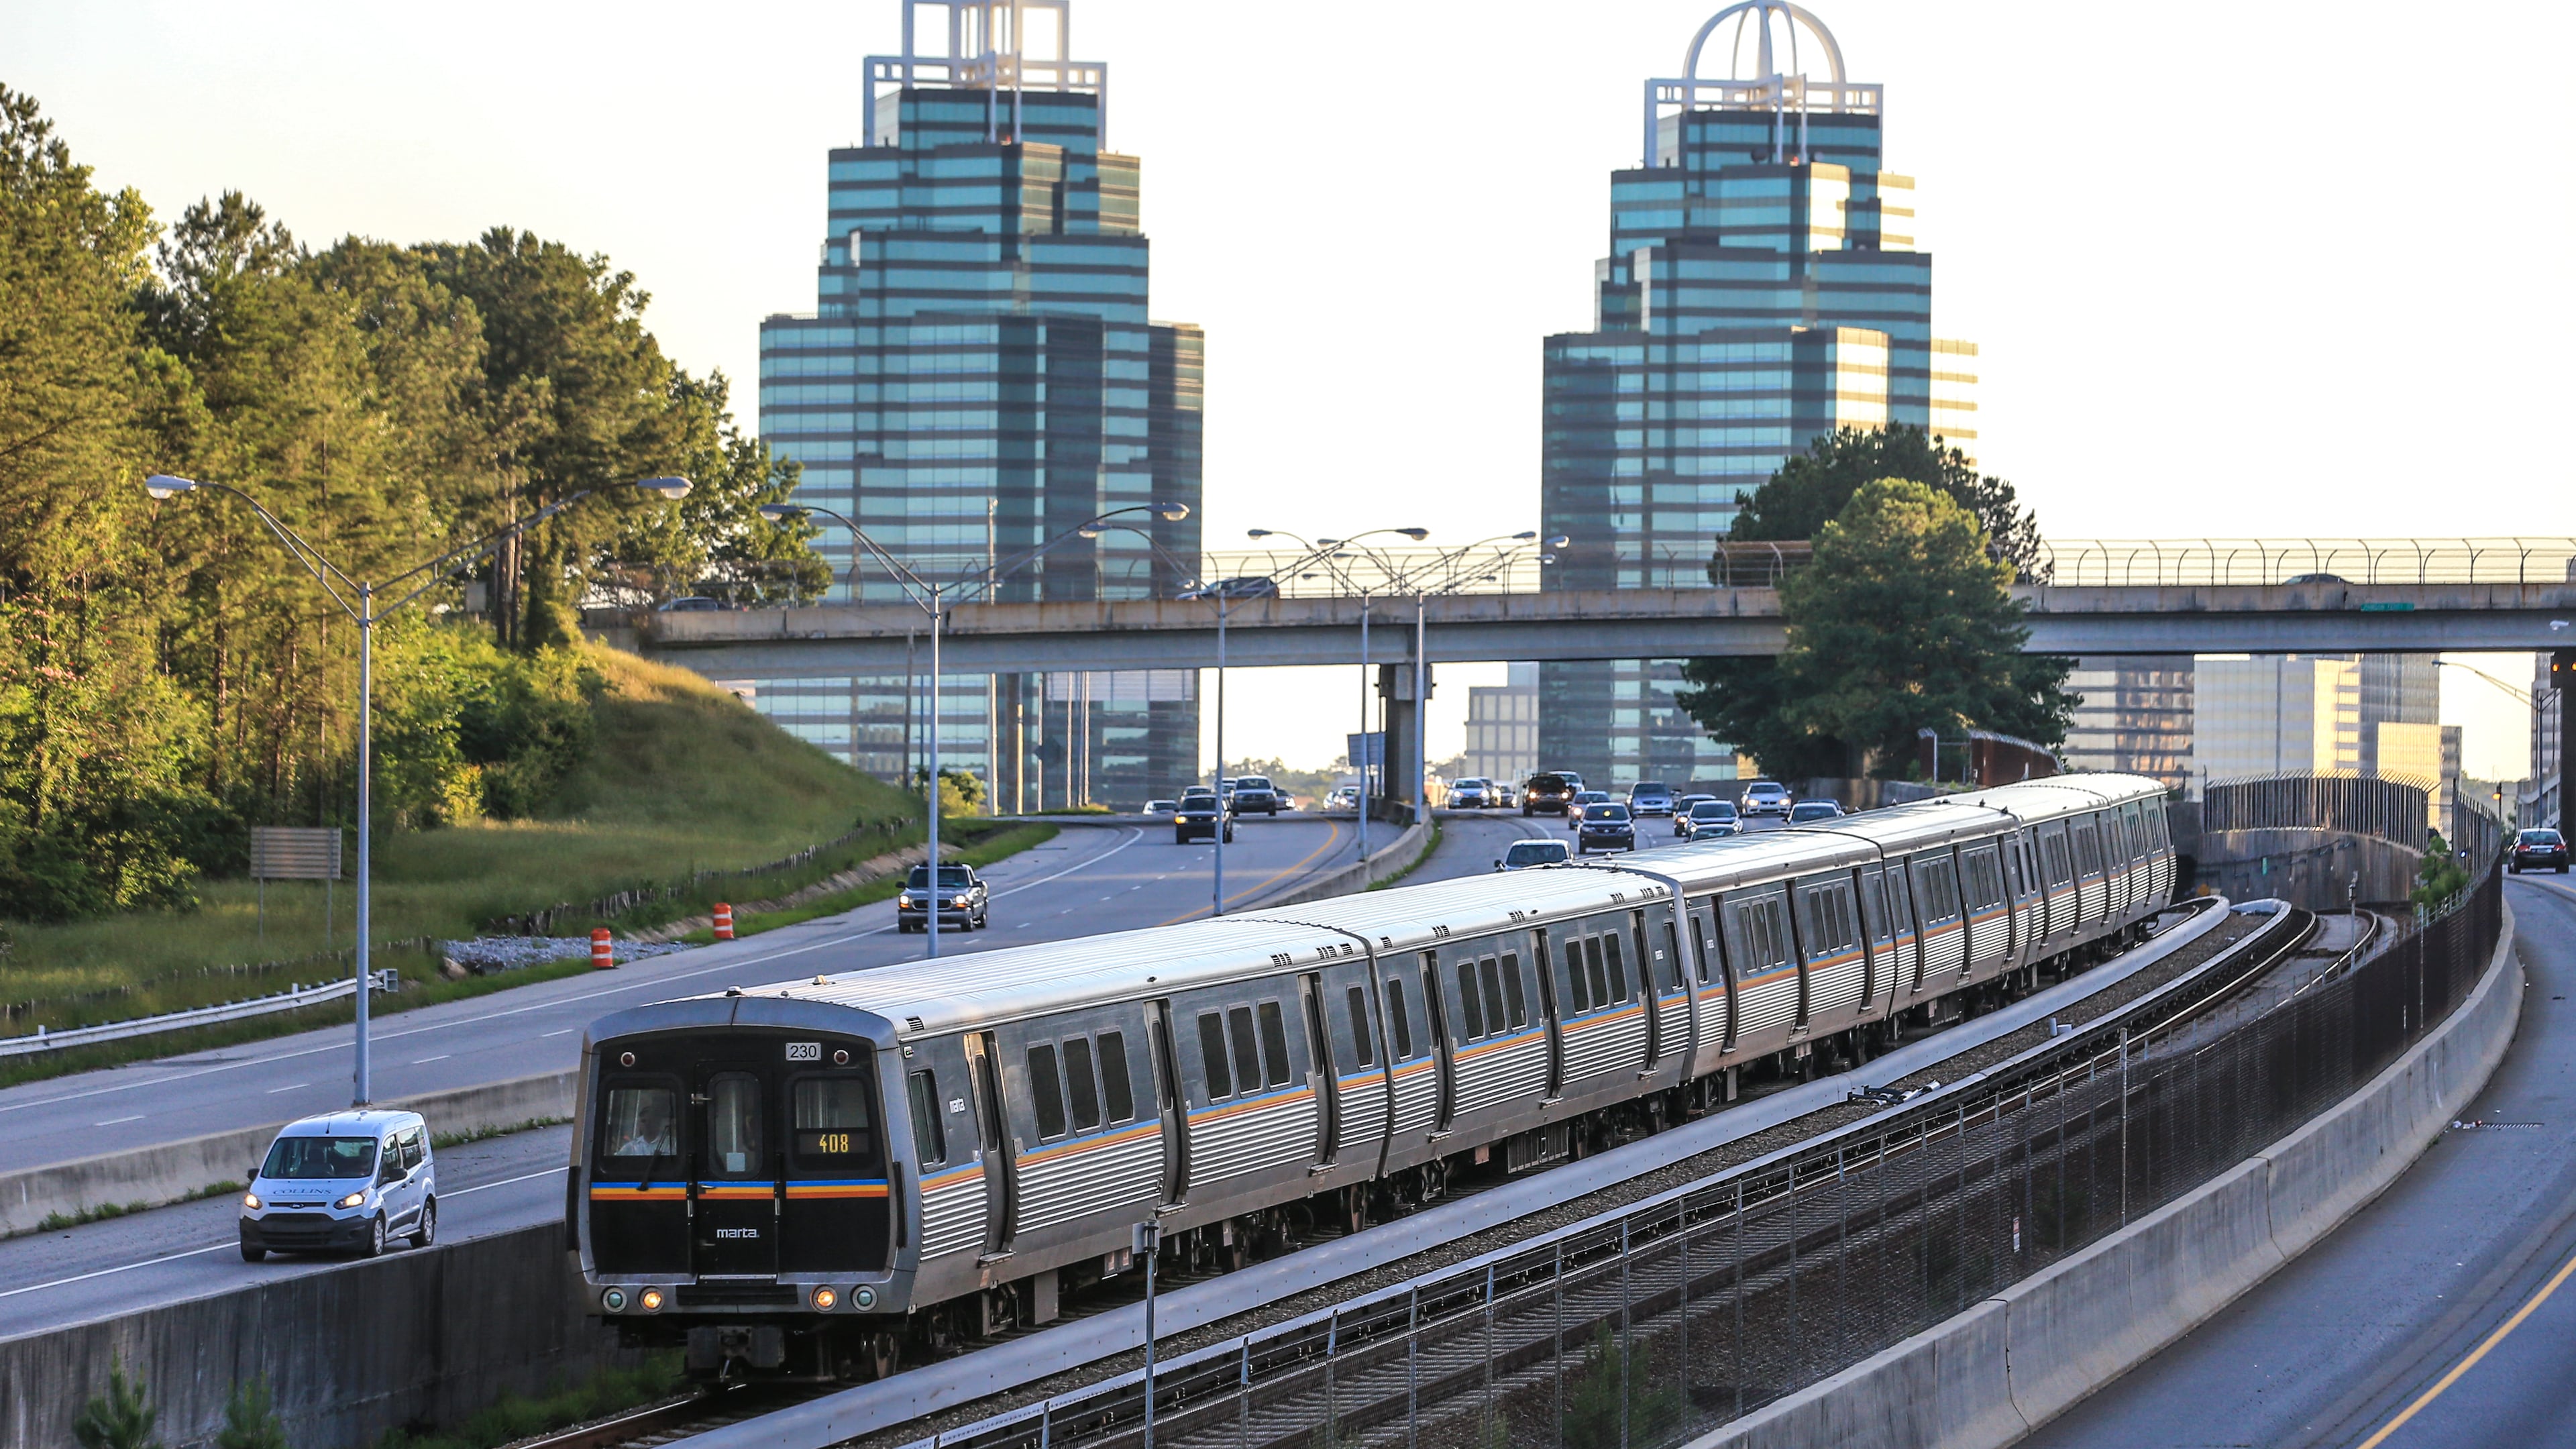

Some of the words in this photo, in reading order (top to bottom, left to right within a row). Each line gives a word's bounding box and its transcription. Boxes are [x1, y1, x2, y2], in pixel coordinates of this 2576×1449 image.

[790, 1045, 816, 1058] 230
[819, 1134, 849, 1153] 408
[716, 1228, 757, 1238] marta
